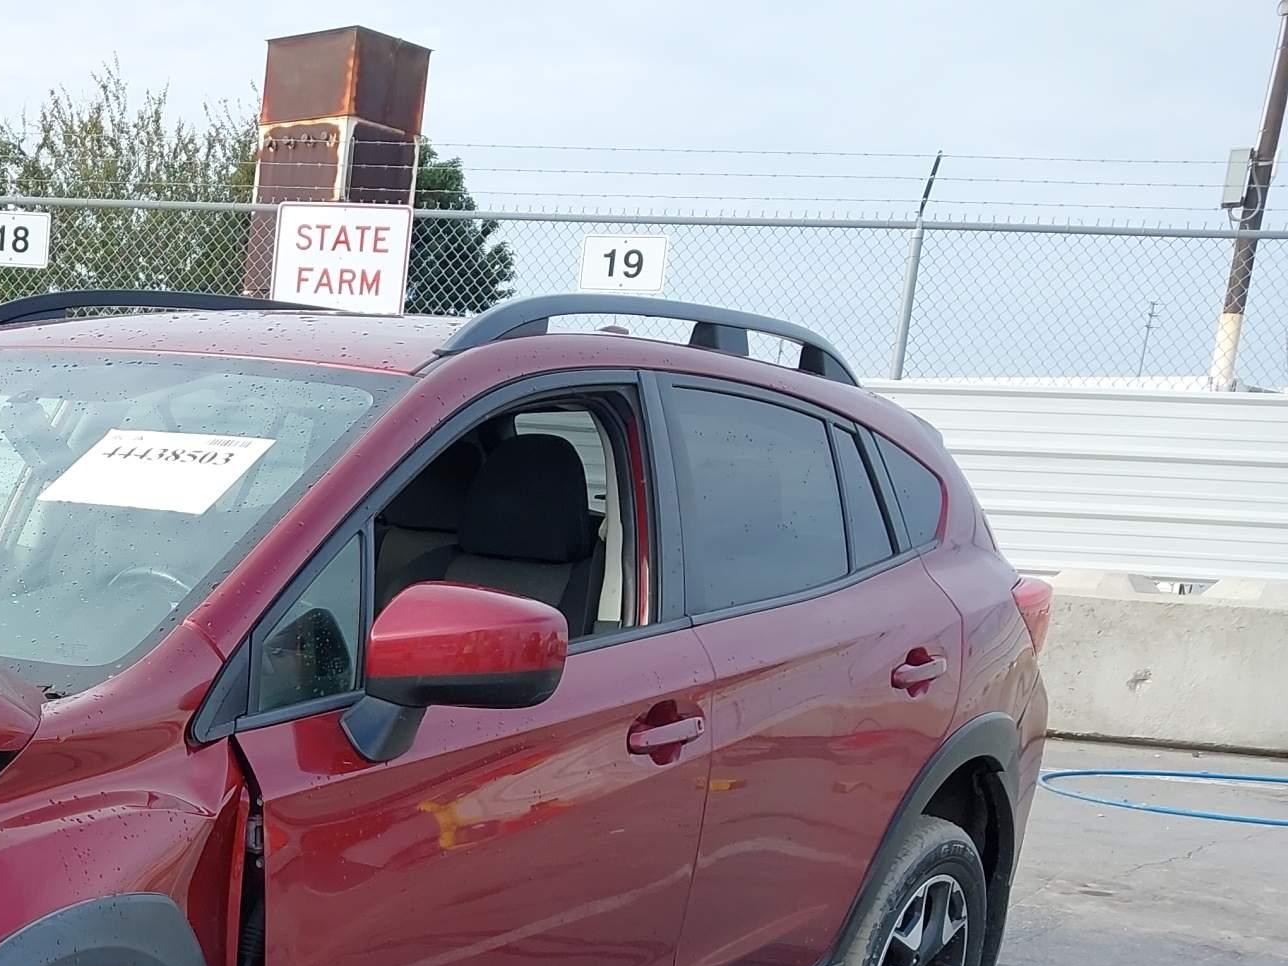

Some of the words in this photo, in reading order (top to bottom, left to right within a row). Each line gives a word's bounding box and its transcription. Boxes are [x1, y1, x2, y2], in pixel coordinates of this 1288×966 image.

[295, 223, 391, 254] STATE
[603, 248, 644, 279] 19
[295, 266, 382, 297] FARM
[101, 445, 236, 466] 44438503
